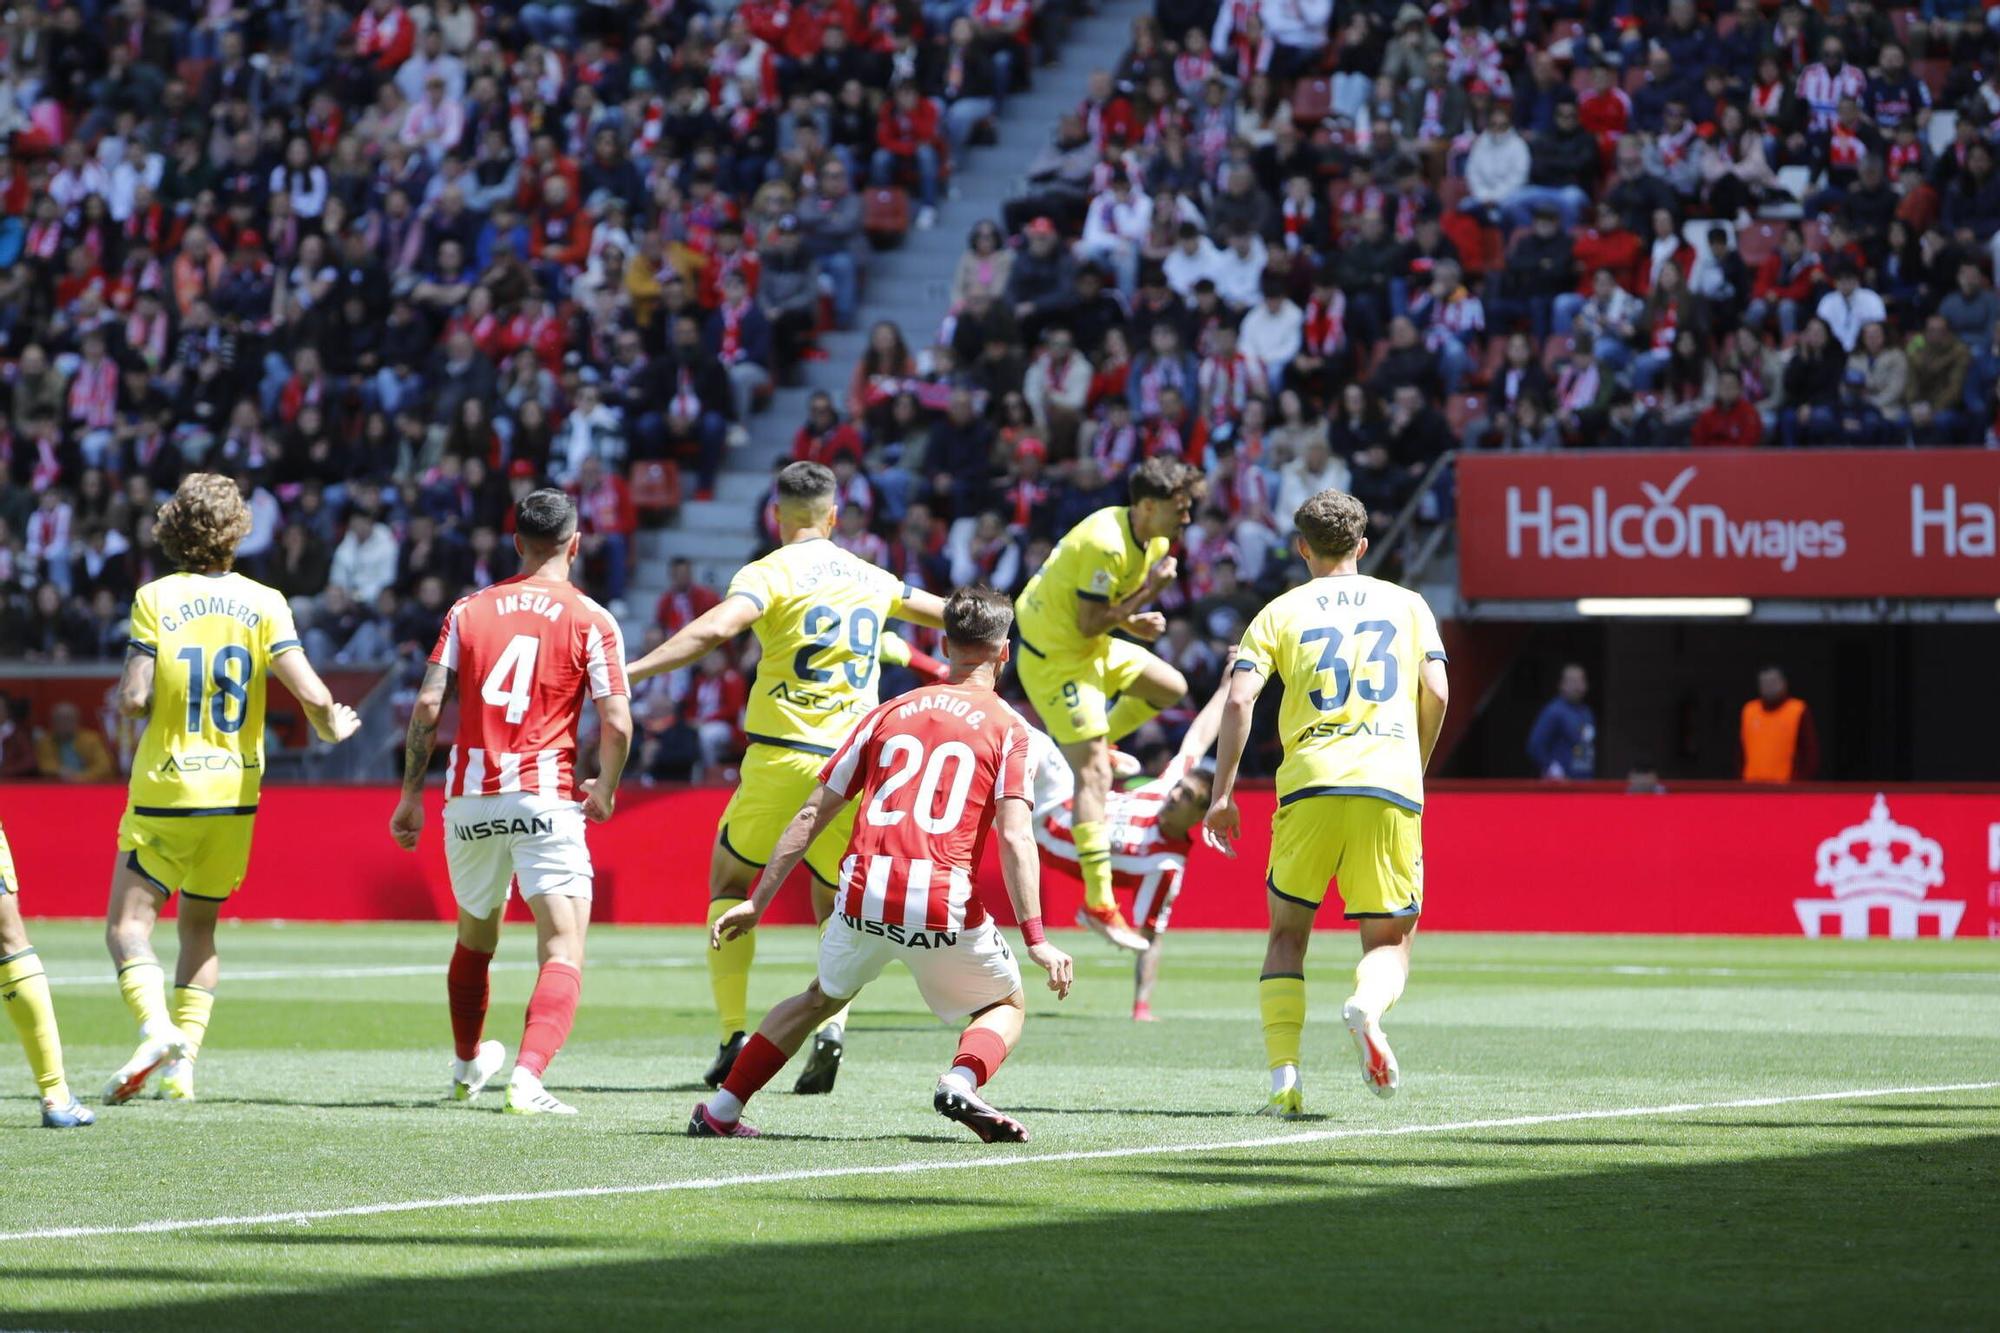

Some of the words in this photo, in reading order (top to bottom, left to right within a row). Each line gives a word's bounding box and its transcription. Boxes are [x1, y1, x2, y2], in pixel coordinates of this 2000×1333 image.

[161, 596, 260, 632] C.ROMERO
[495, 593, 563, 622] INSUA
[1315, 590, 1367, 612] PAU
[793, 604, 880, 690] 29
[480, 634, 540, 725] 4
[1299, 619, 1399, 712] 33
[177, 645, 253, 734] 18
[898, 693, 972, 721] MARIO
[1062, 680, 1079, 708] 9
[1297, 721, 1406, 743] ASCALE
[865, 733, 977, 835] 20
[453, 816, 553, 842] NISSAN
[838, 911, 957, 949] NISSAN
